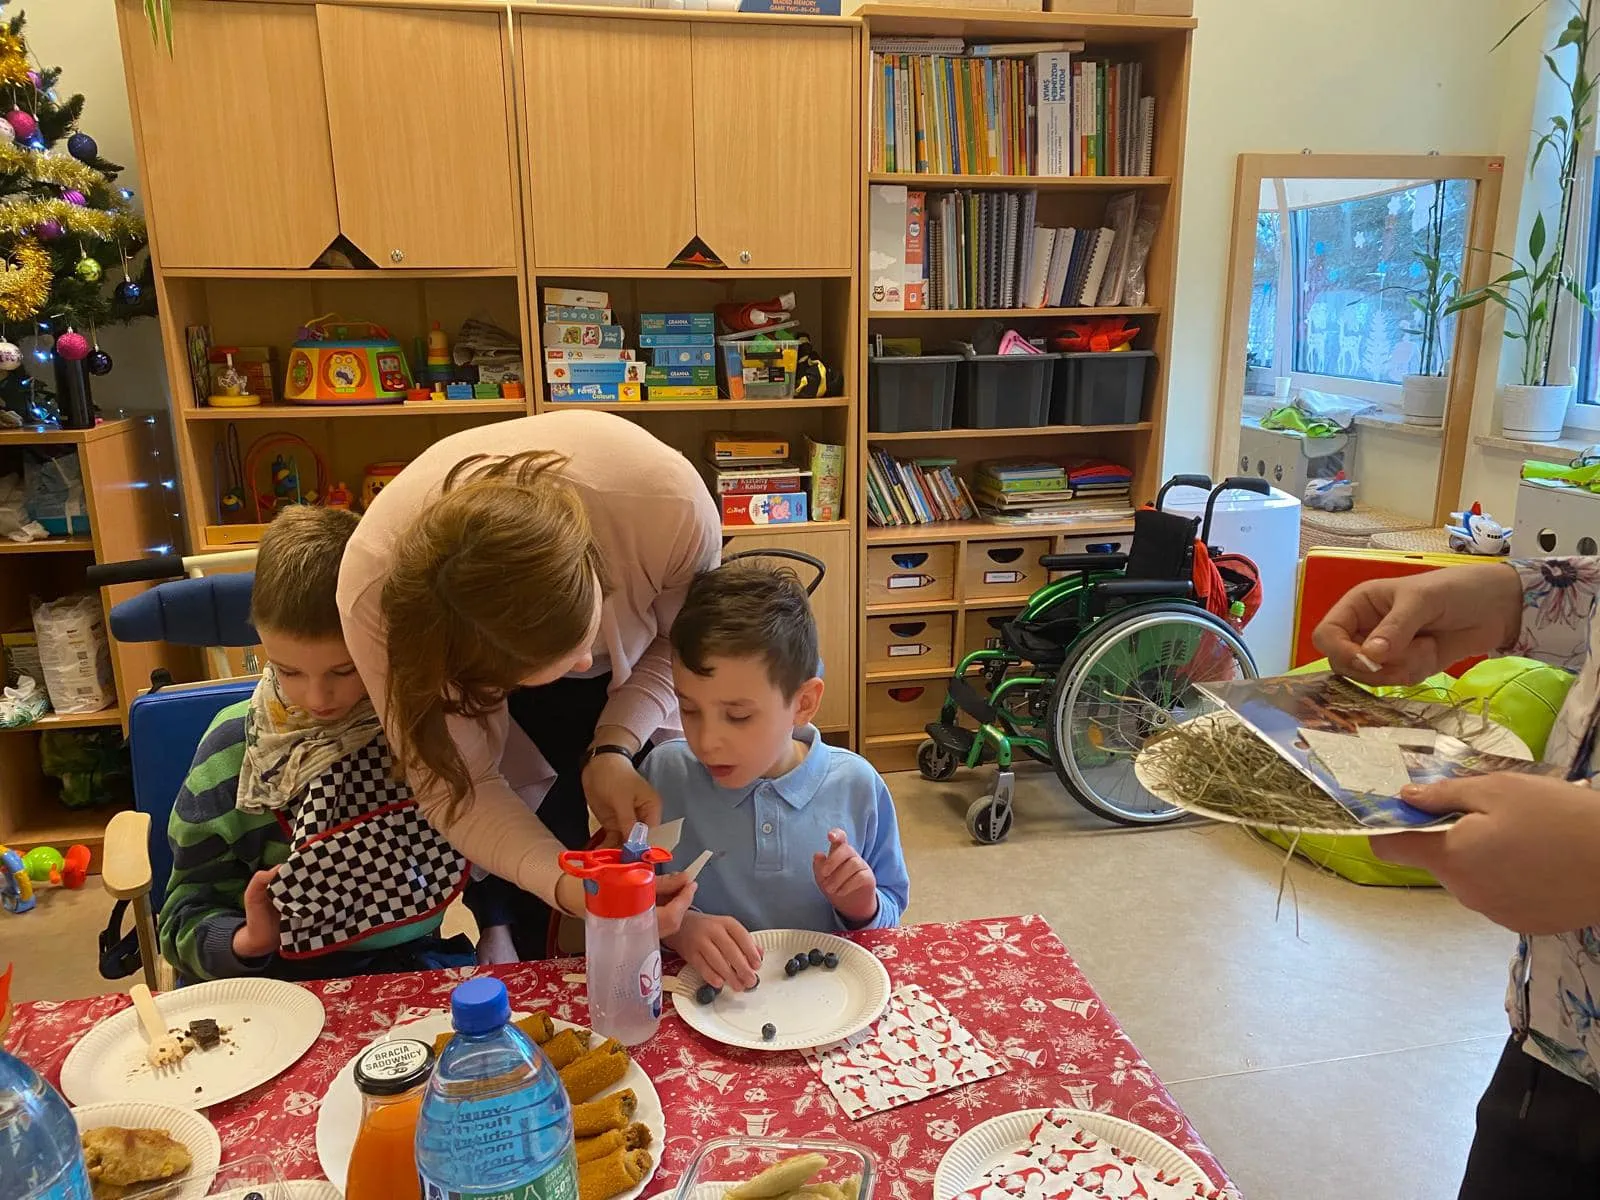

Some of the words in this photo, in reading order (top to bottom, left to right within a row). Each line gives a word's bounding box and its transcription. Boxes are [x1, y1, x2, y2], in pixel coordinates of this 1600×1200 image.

[365, 1049, 422, 1071] SADOWNICY
[374, 1045, 409, 1061] BRACIA
[473, 1192, 514, 1200] TEM
